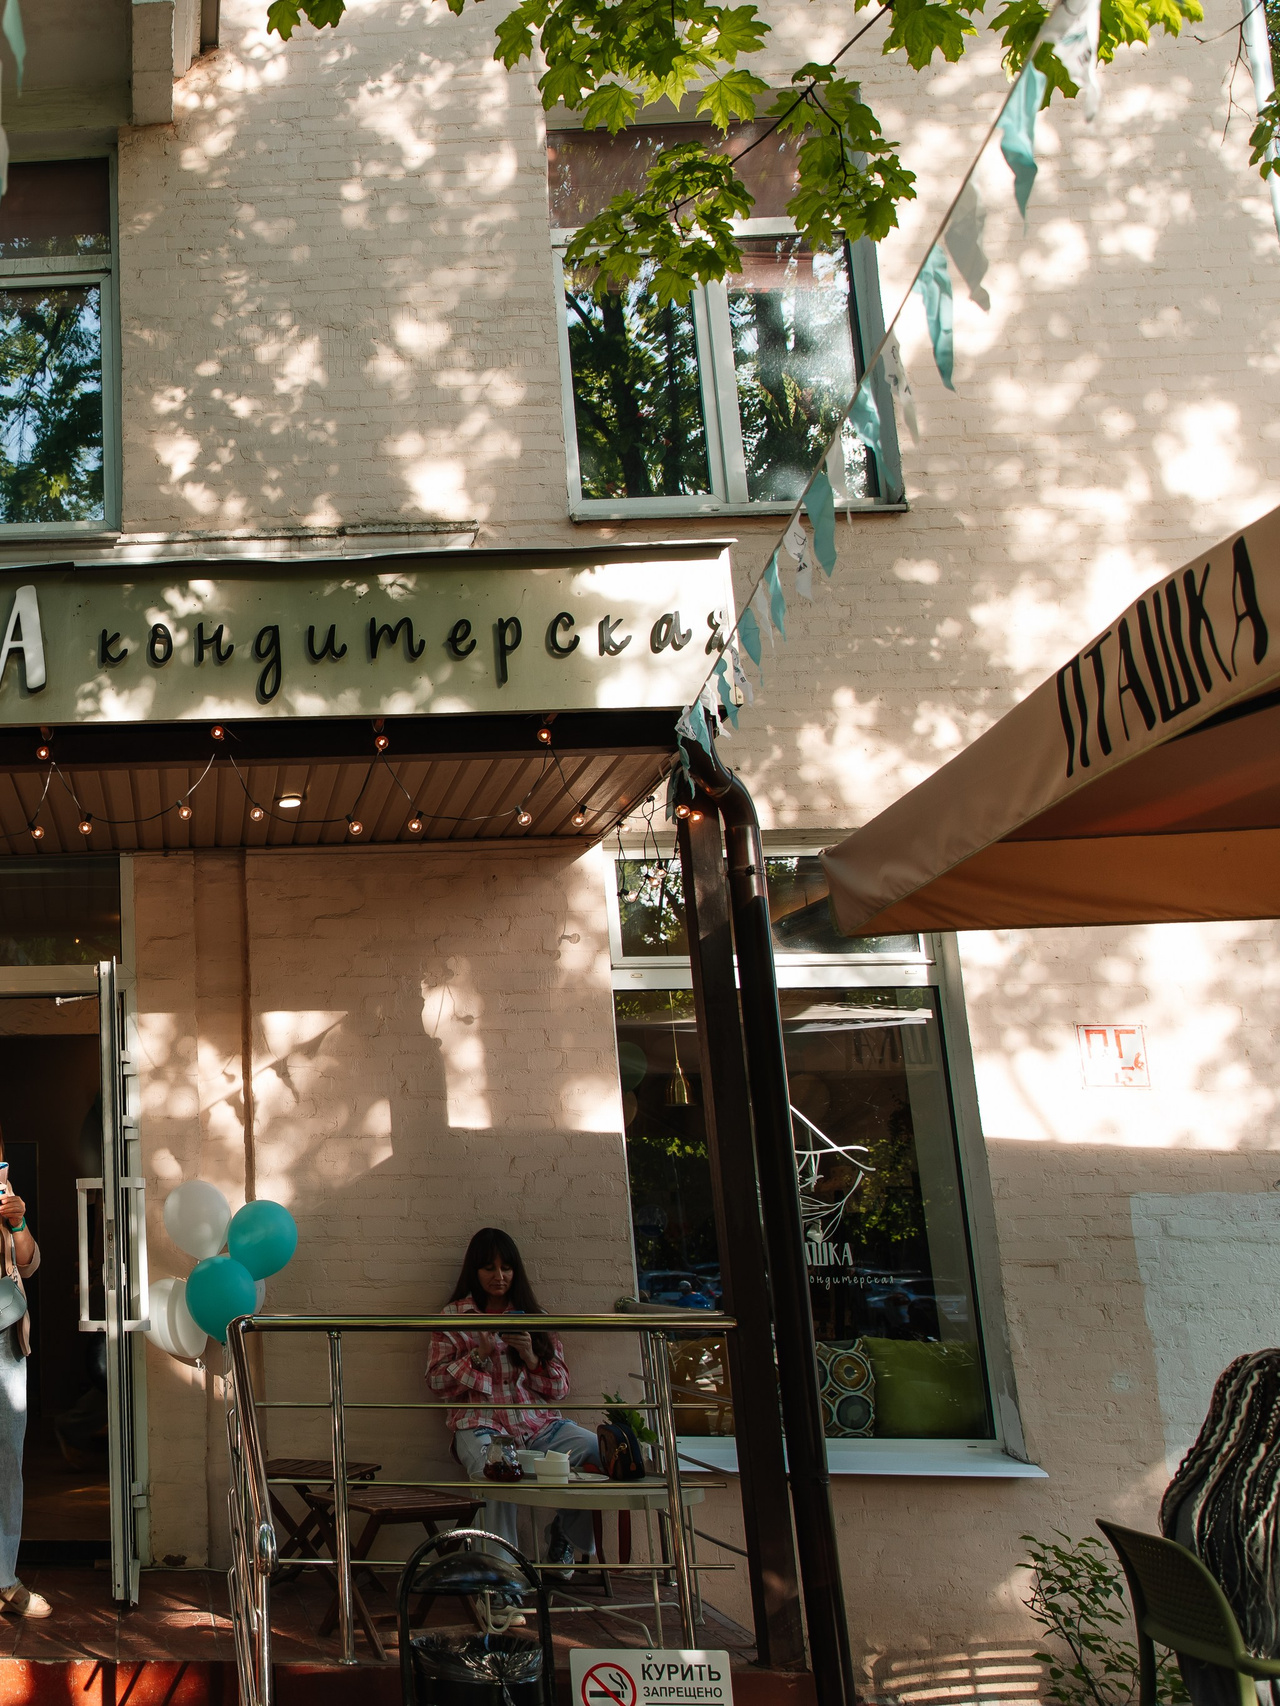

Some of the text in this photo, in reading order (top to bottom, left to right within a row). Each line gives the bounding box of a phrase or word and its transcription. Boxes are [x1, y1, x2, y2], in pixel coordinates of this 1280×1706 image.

[99, 607, 727, 703] кондитерская
[1056, 536, 1268, 778] ПТАШКА
[809, 1275, 894, 1290] ондитерская
[641, 1663, 721, 1681] КУРИТЬ
[642, 1686, 723, 1699] ЗАПРЕЩЕНО
